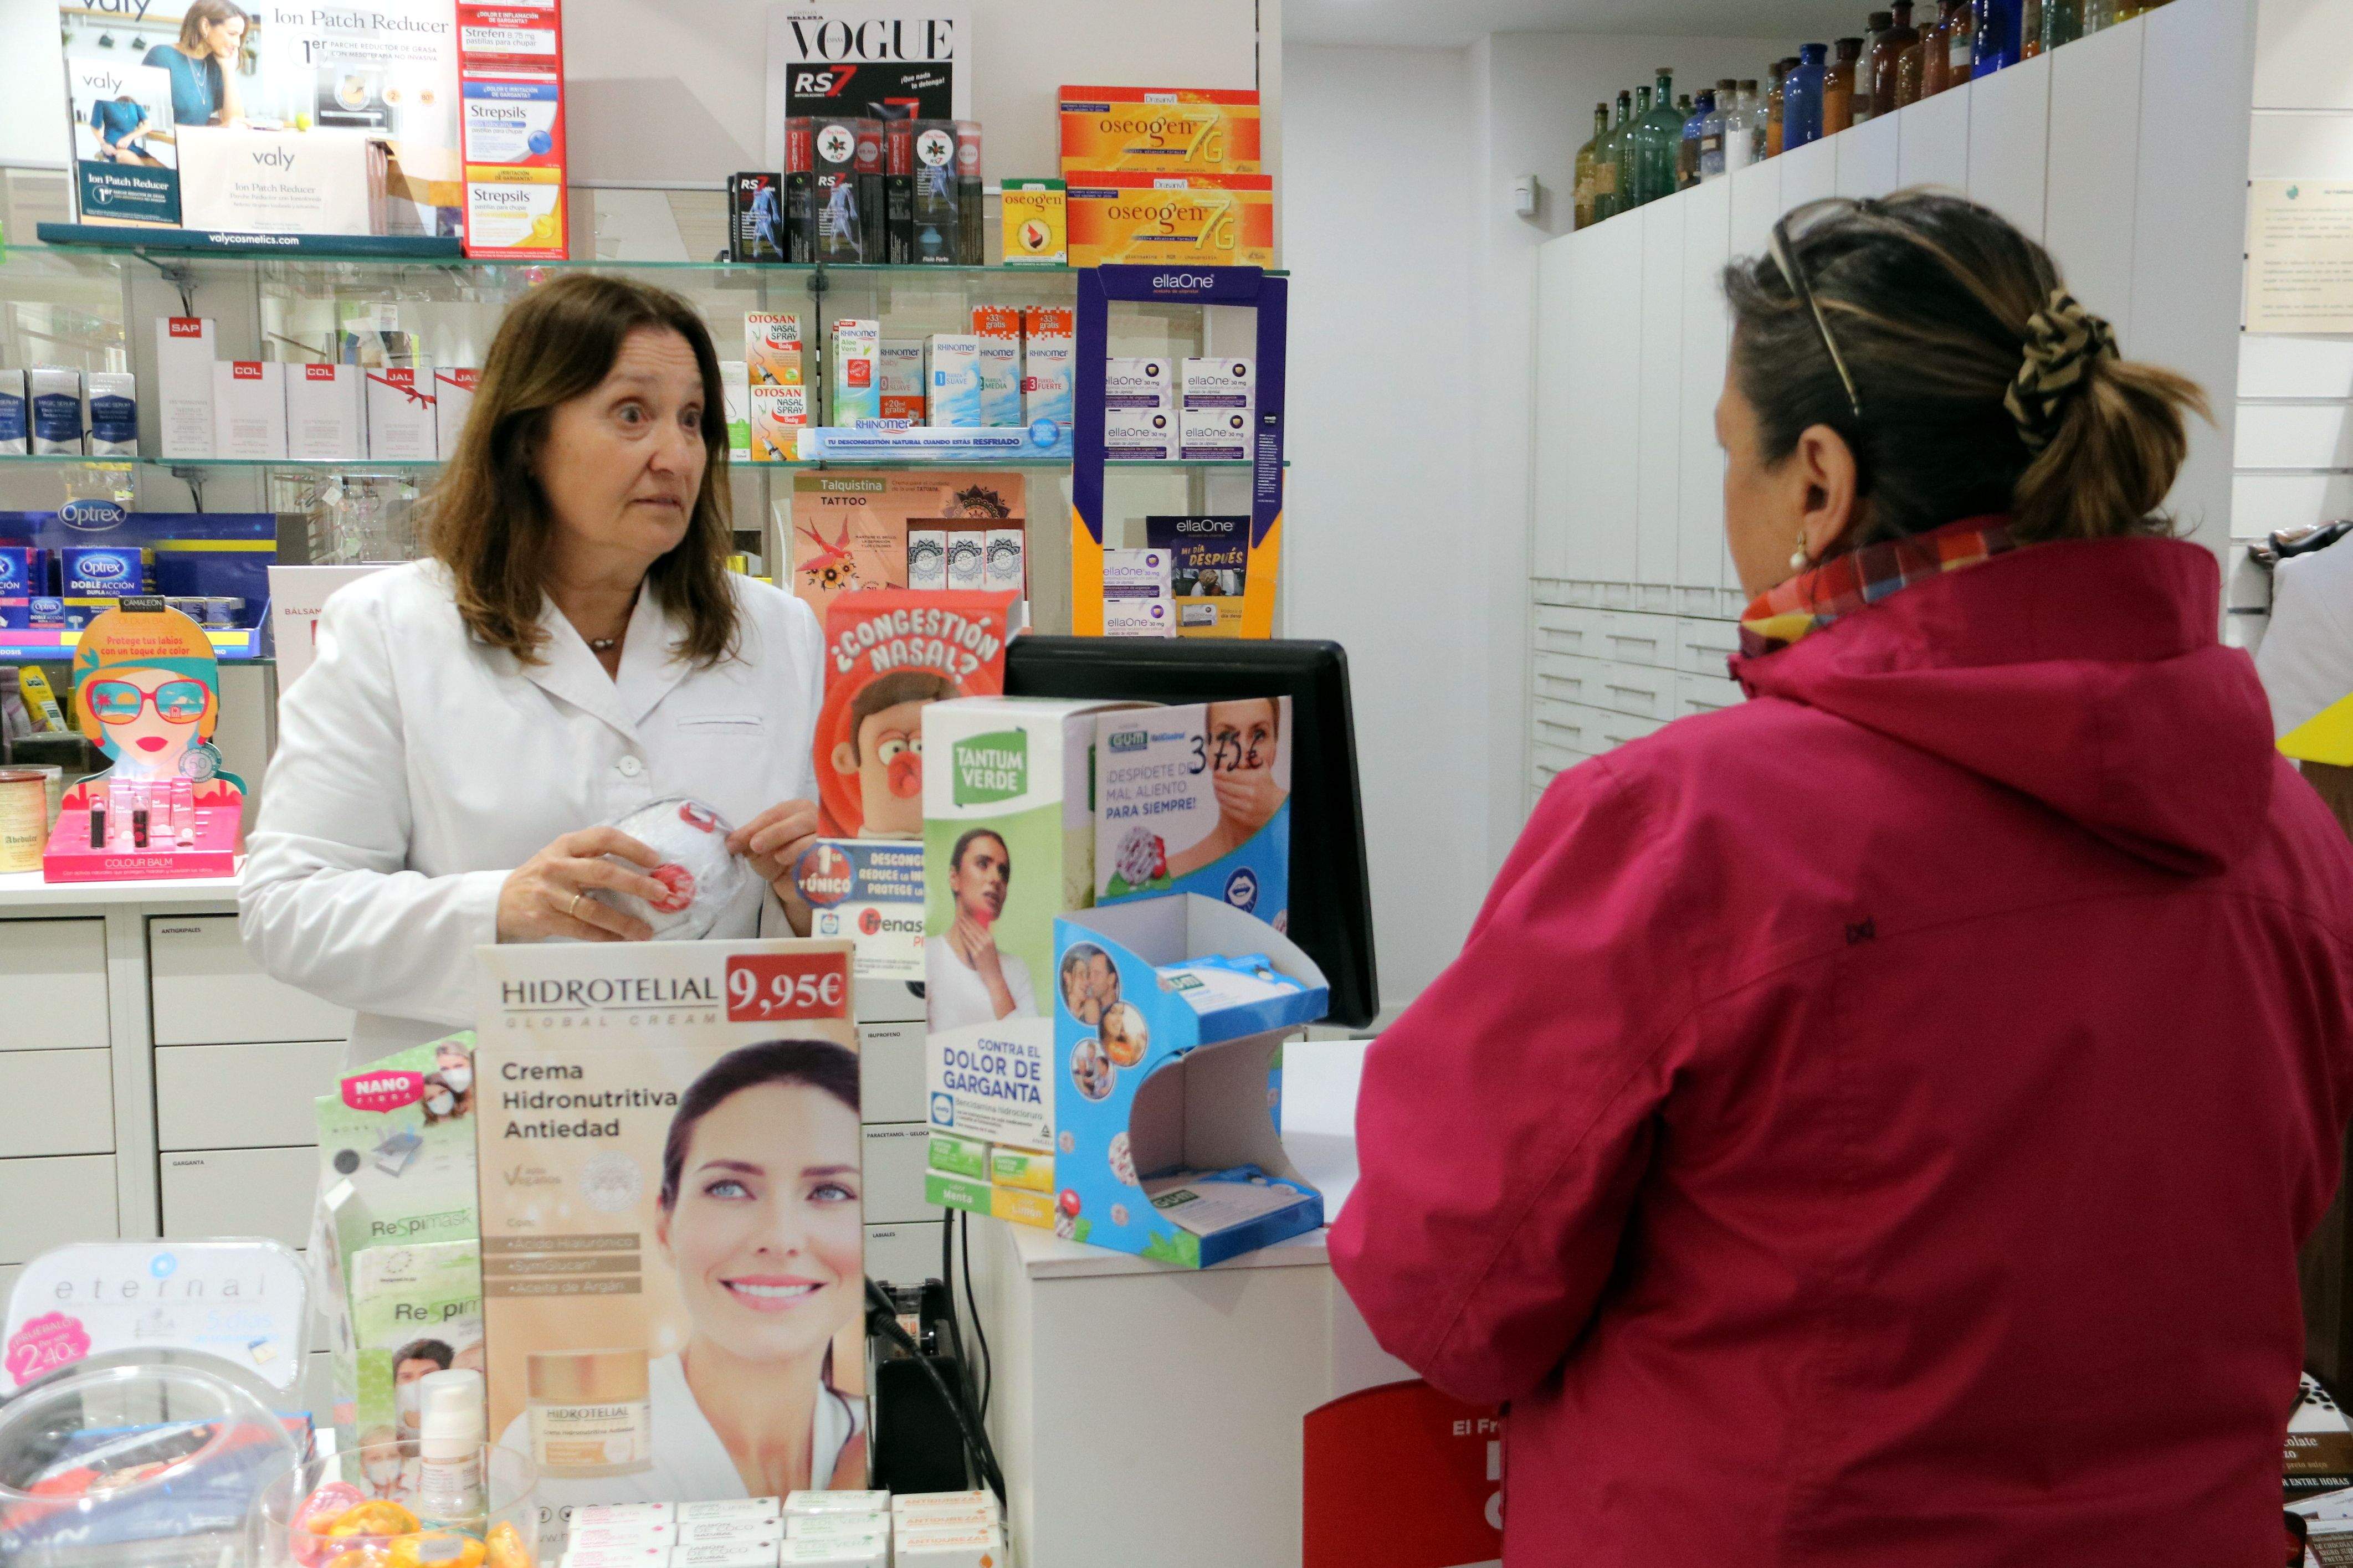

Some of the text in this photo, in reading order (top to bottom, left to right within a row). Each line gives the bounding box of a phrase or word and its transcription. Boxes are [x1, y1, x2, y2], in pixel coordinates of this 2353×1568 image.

[274, 8, 449, 33] Ion Patch Reducer
[466, 28, 505, 38] Strefen
[790, 19, 953, 60] VOGUE
[83, 71, 122, 94] valy
[794, 64, 857, 97] RS7
[471, 105, 526, 121] Strepsils
[1100, 117, 1193, 147] oseogen
[253, 146, 295, 171] valy
[88, 173, 169, 190] Ion Patch Reducer
[741, 176, 769, 192] RS7
[818, 172, 847, 188] RS7
[235, 183, 316, 193] Ion Patch Reducer
[474, 189, 530, 204] Strepsils
[1005, 194, 1062, 211] oseogen
[1108, 203, 1203, 234] oseogen
[209, 233, 299, 245] valycosmetics.com
[1153, 274, 1213, 289] ellaOne
[749, 315, 796, 323] OTOSAN
[986, 321, 1006, 330] gratis
[1039, 322, 1059, 330] gratis
[172, 323, 199, 333] SAP
[778, 343, 793, 351] Baby
[235, 366, 262, 376] COL
[307, 367, 332, 377] COL
[388, 371, 412, 382] JAL
[458, 372, 480, 382] JAL
[1188, 377, 1229, 385] ellaOne
[754, 388, 802, 398] OTOSAN
[777, 406, 804, 414] SPRAY
[783, 417, 799, 425] Baby
[1109, 428, 1149, 437] ellaOne
[1186, 428, 1227, 437] ellaOne
[821, 480, 882, 492] Talquistina
[821, 497, 866, 505] TATTOO
[62, 505, 121, 525] Optrex
[1176, 519, 1233, 532] ellaOne
[1190, 547, 1243, 566] DESPUÉS
[83, 561, 120, 575] Optrex
[1103, 567, 1142, 576] ellaOne
[102, 581, 135, 589] ACCIÓN
[34, 603, 57, 611] Optrex
[1108, 618, 1147, 627] ellaOne
[107, 635, 183, 647] Protege tus labios
[832, 607, 999, 674] ¿CONGESTIÓN
[130, 647, 155, 657] toque
[157, 646, 167, 655] de
[169, 645, 190, 656] color
[869, 637, 980, 685] NASAL?
[956, 747, 1023, 770] TANTUM
[961, 767, 1018, 791] VERDE
[1107, 780, 1187, 802] MAL ALIENTO
[1106, 798, 1197, 819] PARA SIEMPRE!
[105, 858, 173, 867] COLOUR BALM
[870, 852, 924, 866] DESCONG
[859, 868, 898, 881] REDUCE
[867, 883, 912, 896] PROTEGE
[503, 976, 719, 1007] HIDROTELIAL
[729, 968, 842, 1017] 9,95€
[506, 1012, 716, 1029] GLOBAL CREAM
[978, 1038, 1041, 1058] CONTRA EL
[502, 1062, 584, 1081] Crema
[943, 1047, 1041, 1082] DOLOR DE
[355, 1077, 411, 1094] NANO
[943, 1070, 1042, 1104] GARGANTA
[356, 1092, 412, 1104] FIBRA
[503, 1089, 678, 1111] Hidronutritiva
[998, 1105, 1043, 1121] hidrocloruro
[504, 1119, 621, 1139] Antiedad
[943, 1189, 973, 1204] Menta
[1012, 1205, 1043, 1219] Limón
[55, 1273, 265, 1299] eternal
[562, 1279, 625, 1292] de Argán
[547, 1407, 629, 1420] HIDROTELIAL
[1452, 1419, 1472, 1436] El
[2289, 1478, 2319, 1486] ENTRE
[2319, 1477, 2350, 1486] HORAS
[904, 1497, 983, 1505] ANTIDUREZAS
[906, 1514, 987, 1524] ANTIDUREZAS
[906, 1536, 990, 1545] ANTIDUREZAS
